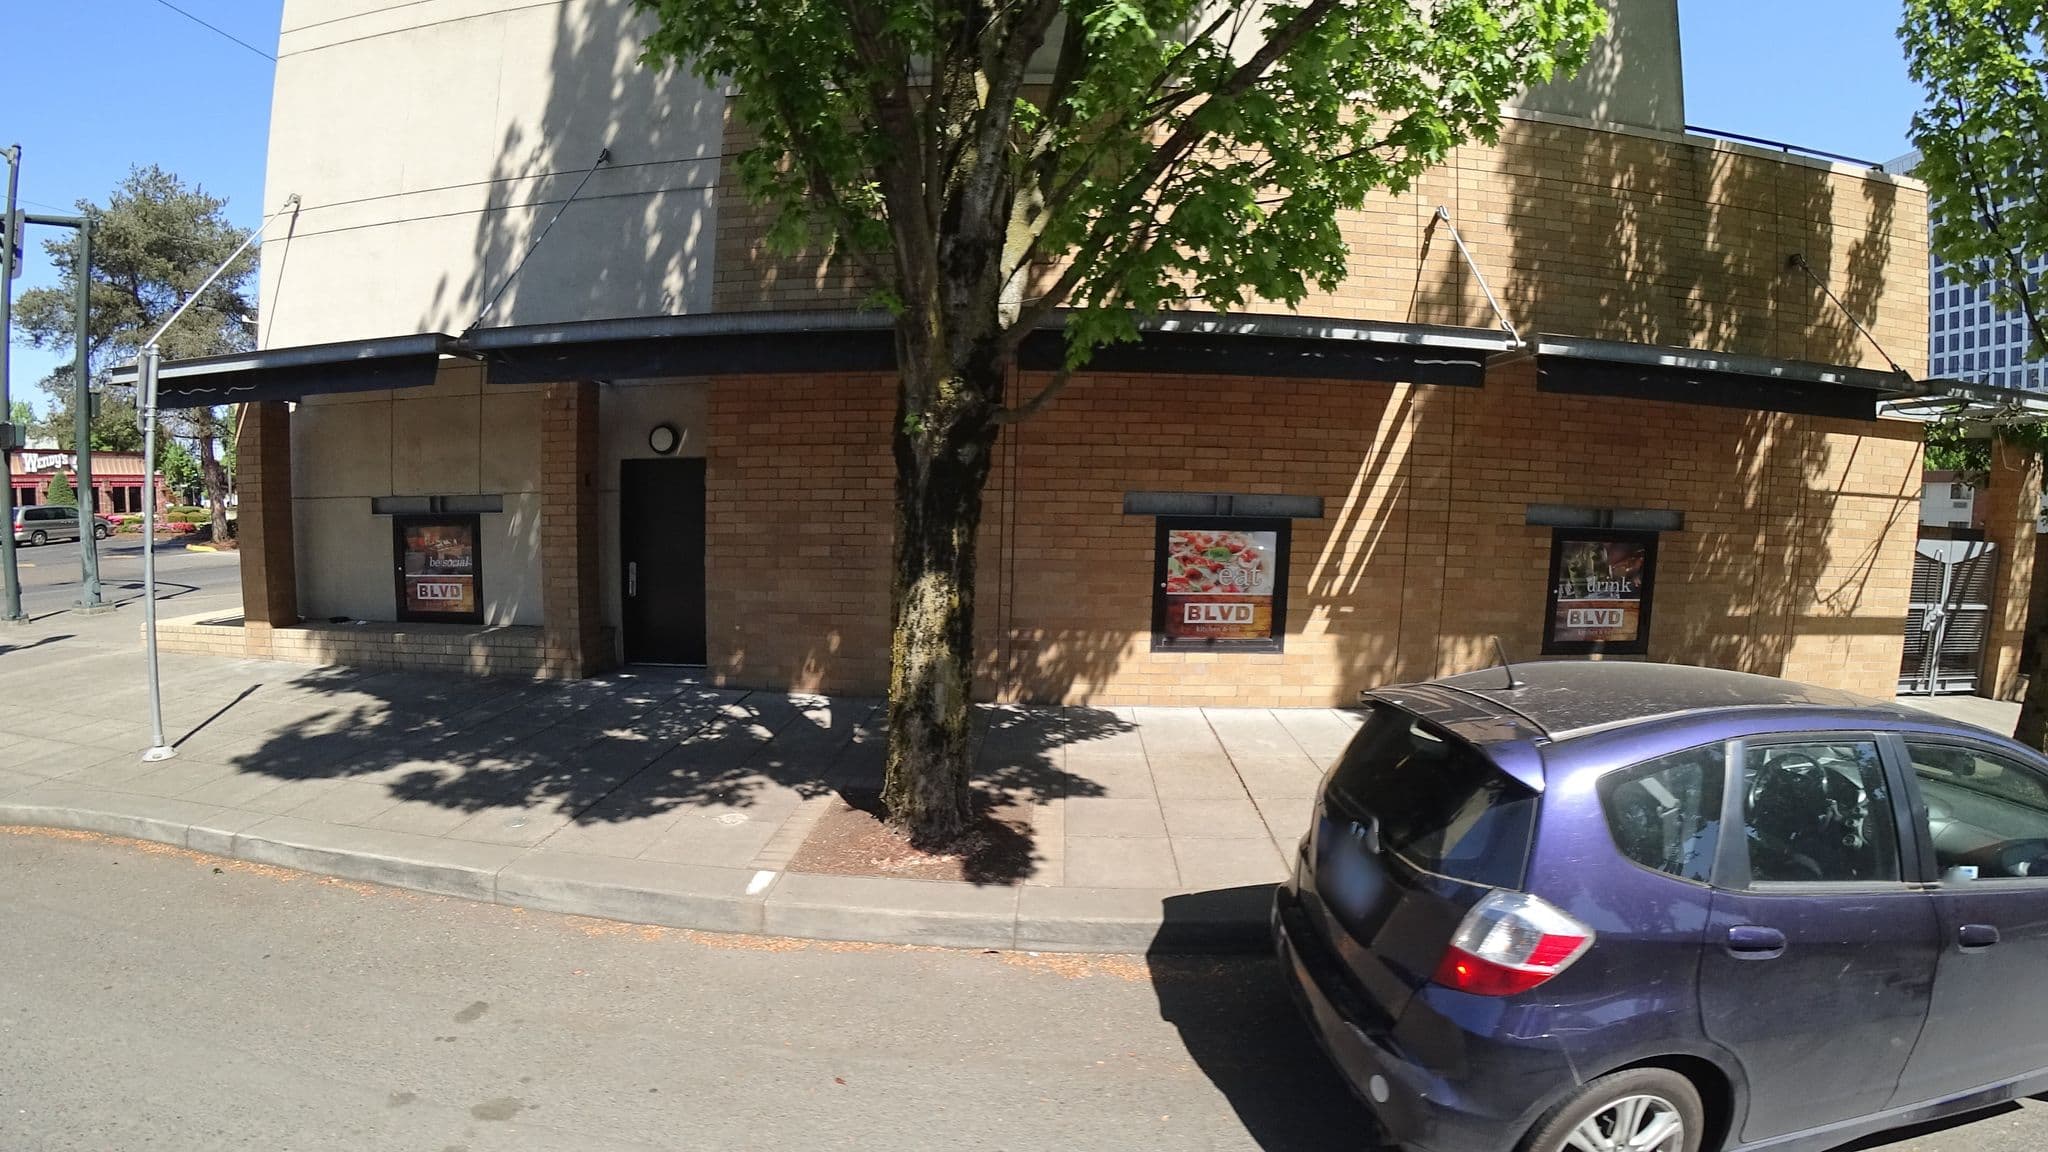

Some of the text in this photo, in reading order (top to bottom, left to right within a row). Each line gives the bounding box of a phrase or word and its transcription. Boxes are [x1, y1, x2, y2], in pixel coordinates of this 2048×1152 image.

[1219, 565, 1262, 586] eat
[419, 585, 460, 597] BLVD
[1587, 575, 1632, 593] drink
[1188, 605, 1250, 620] BLVD
[1570, 610, 1621, 625] BLVD
